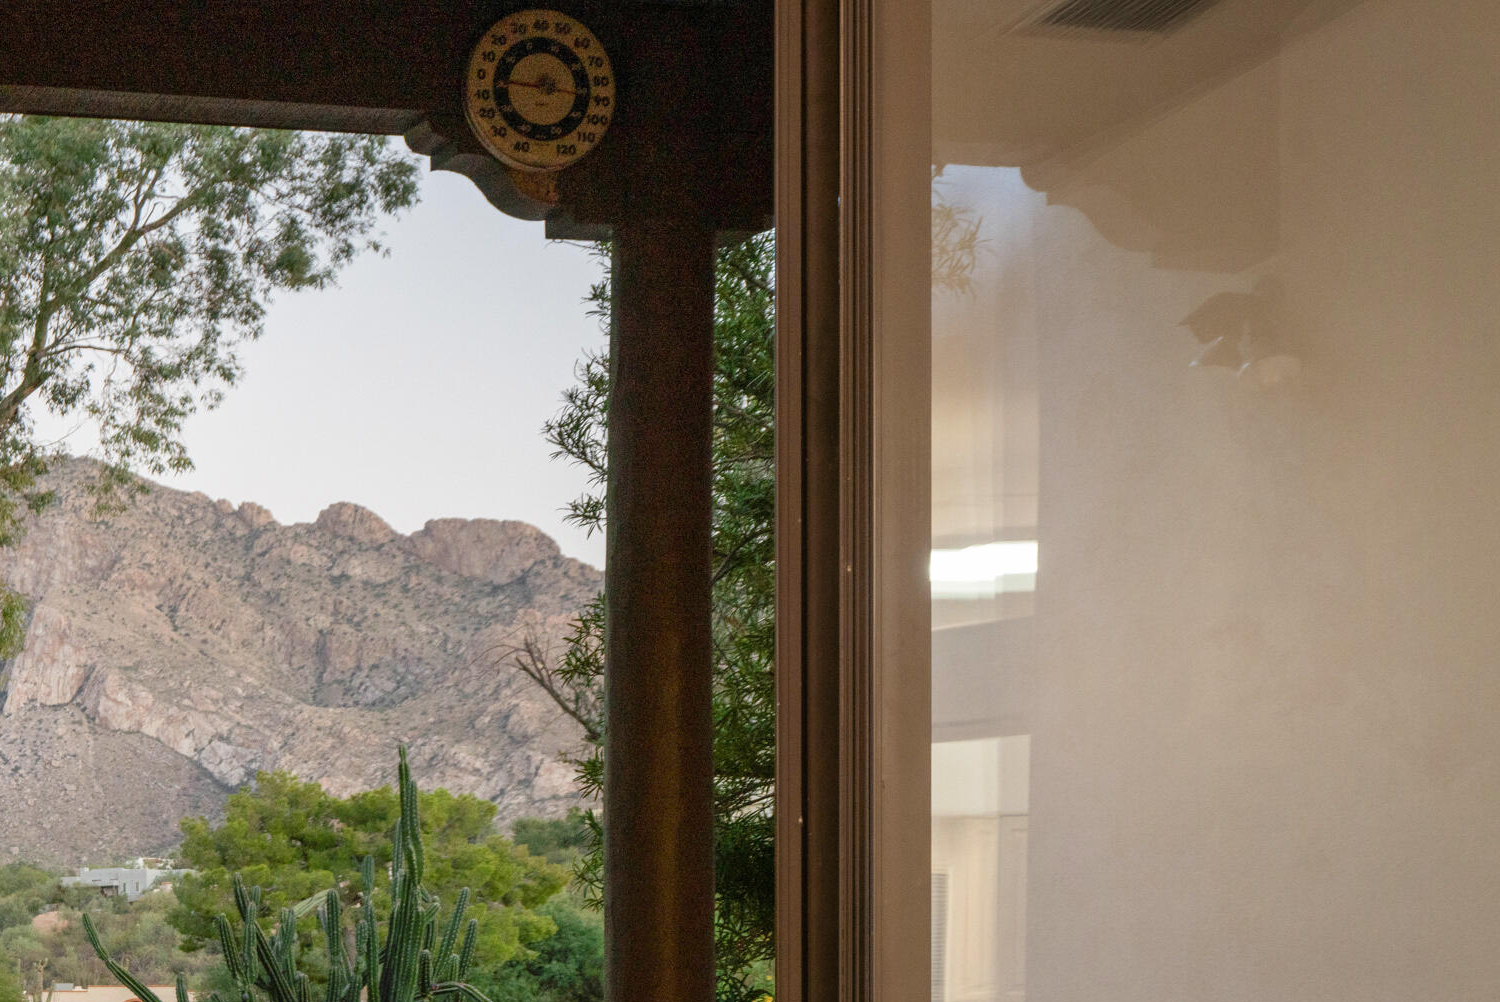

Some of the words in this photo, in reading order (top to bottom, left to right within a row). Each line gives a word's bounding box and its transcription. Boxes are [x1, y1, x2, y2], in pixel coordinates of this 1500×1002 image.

[588, 56, 603, 67] 70
[586, 115, 608, 125] 100
[514, 142, 530, 152] 40
[557, 145, 576, 155] 120
